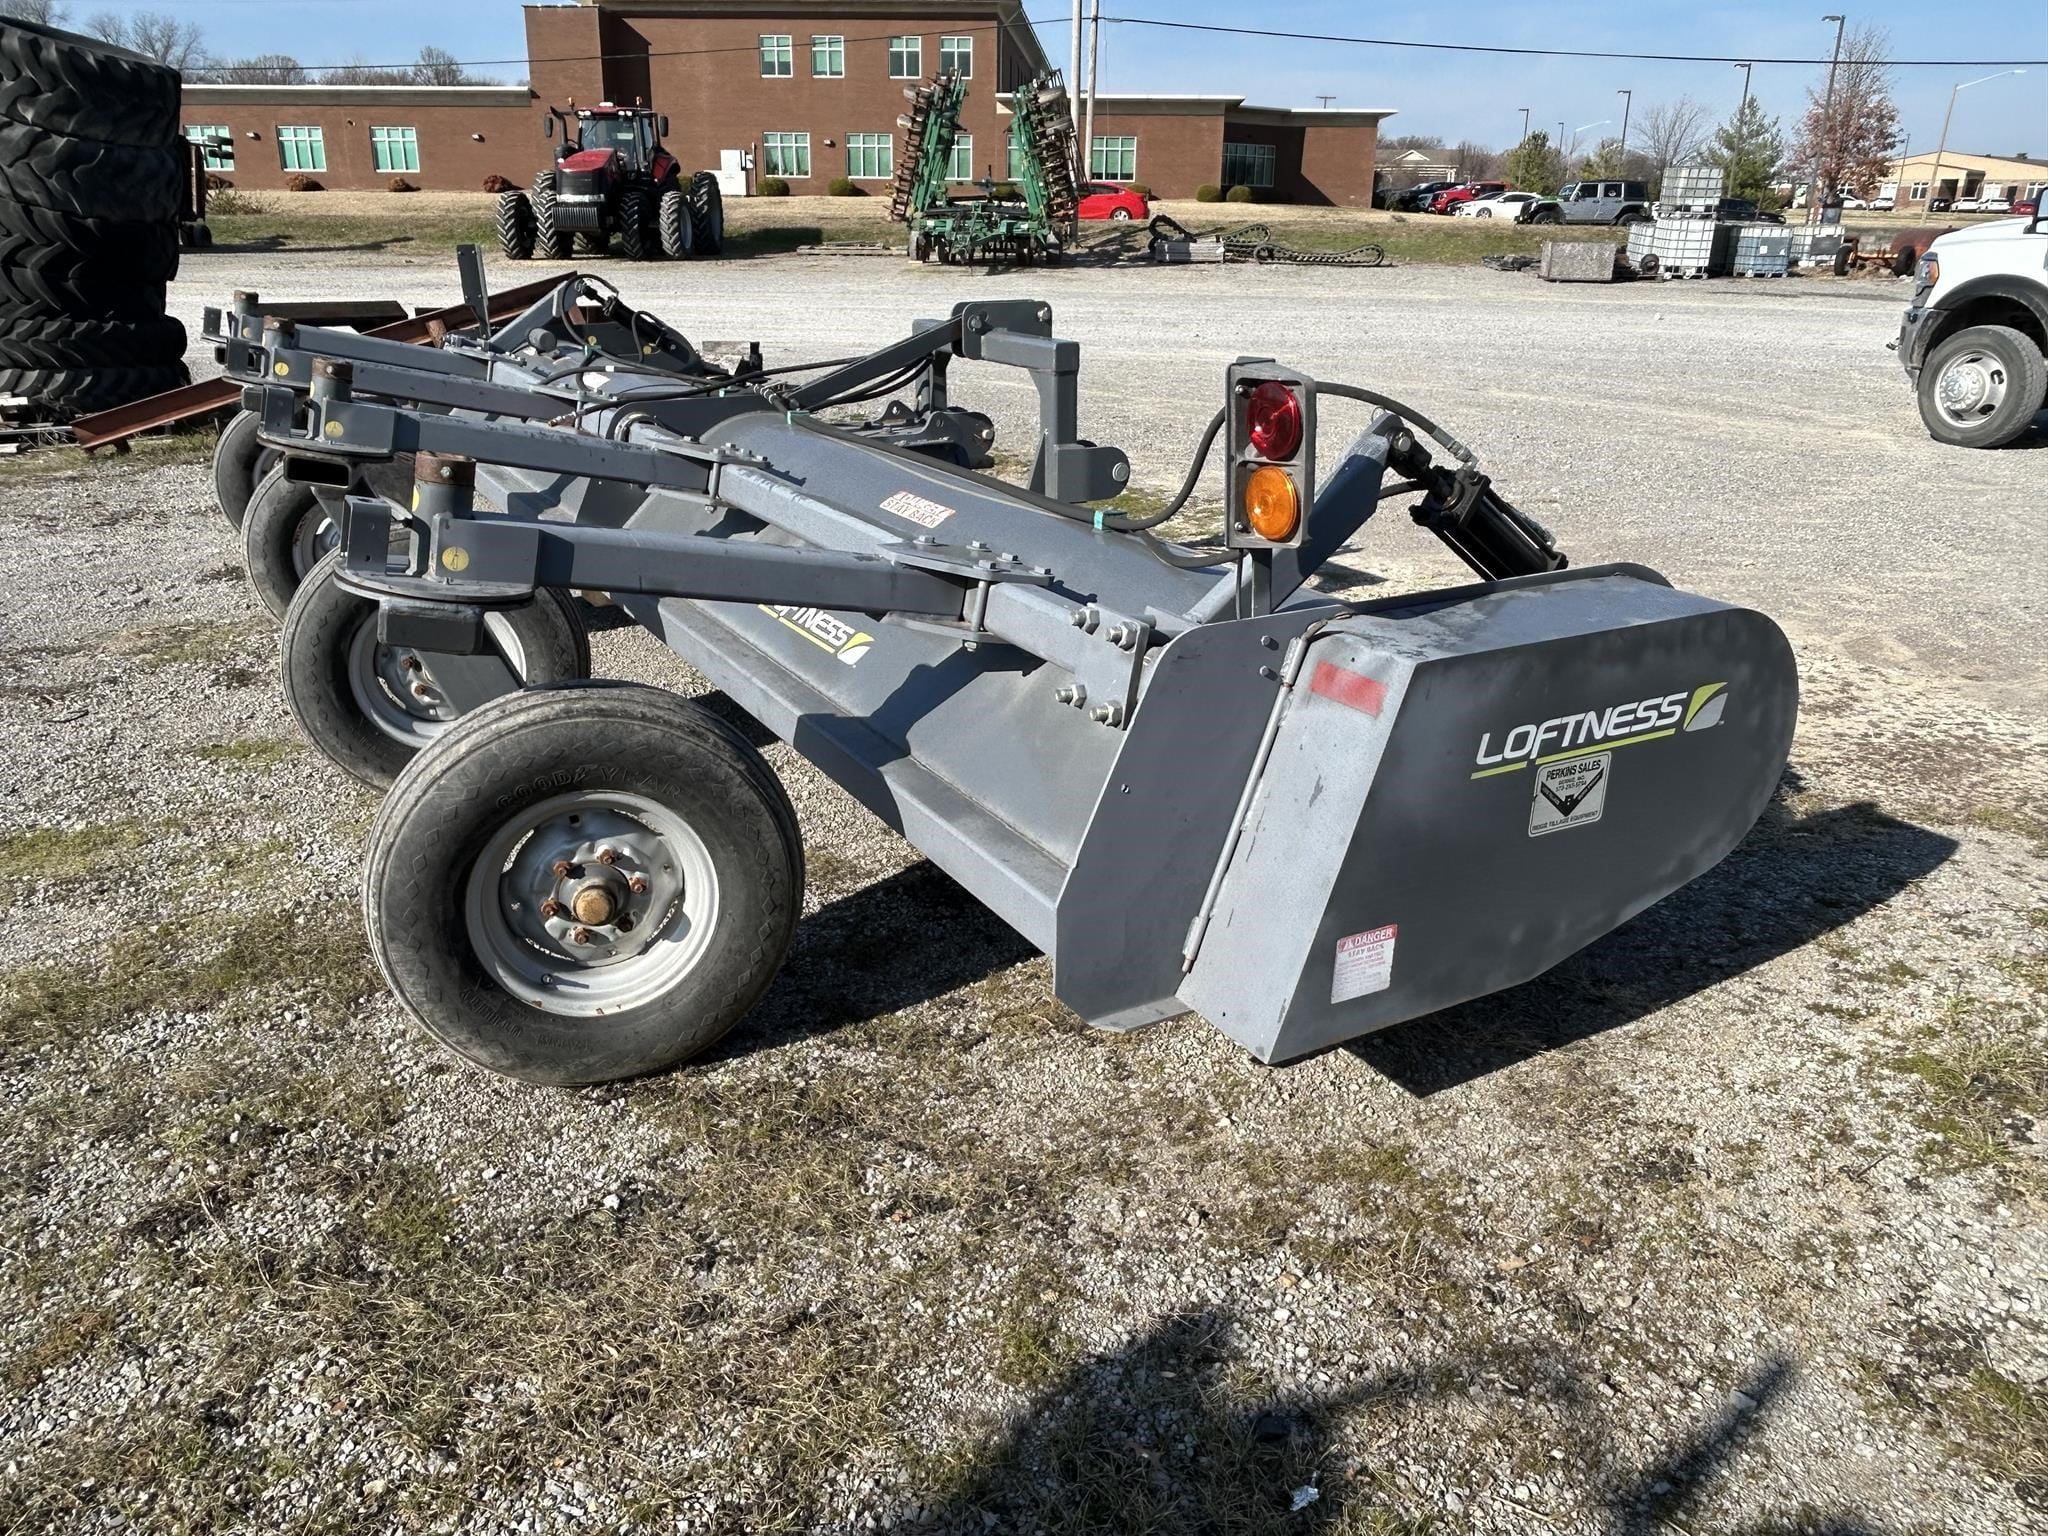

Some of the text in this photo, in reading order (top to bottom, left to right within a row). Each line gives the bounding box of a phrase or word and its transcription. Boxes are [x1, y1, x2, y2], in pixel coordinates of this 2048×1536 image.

[883, 499, 938, 526] STAY BACK
[1476, 692, 1688, 765] LOFTNESS
[1546, 765, 1577, 781] PERKINS
[1578, 760, 1601, 774] SALES
[1355, 927, 1393, 946] DANGER
